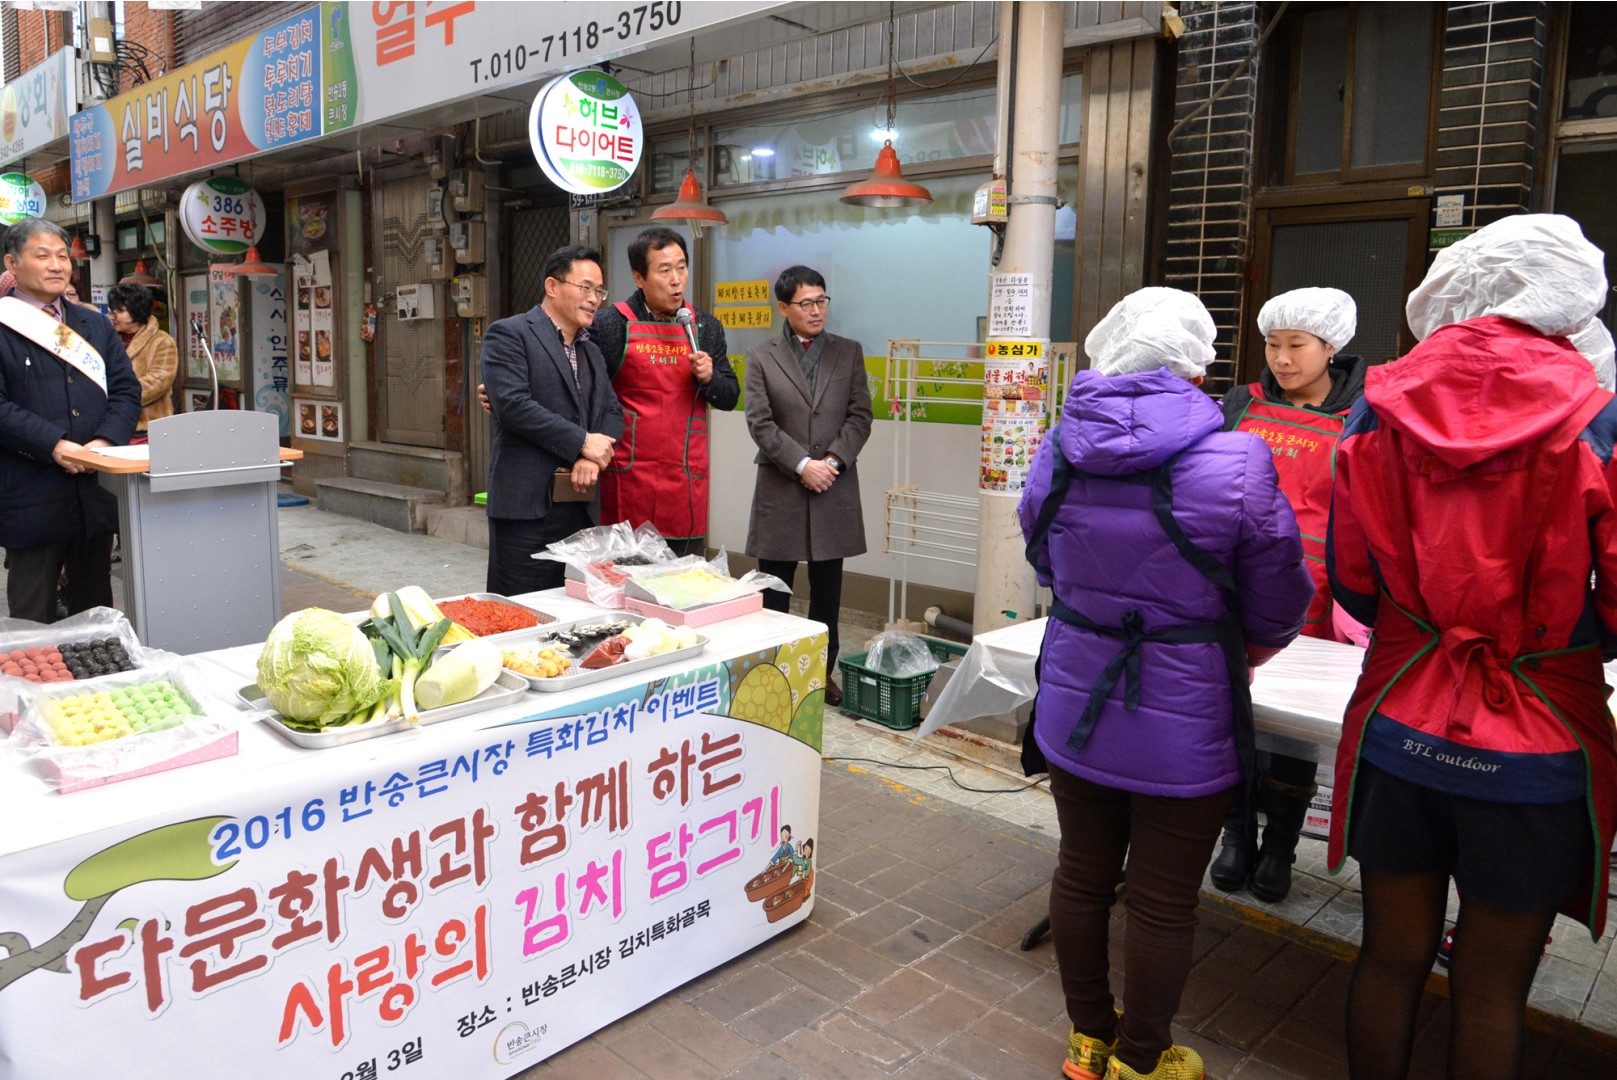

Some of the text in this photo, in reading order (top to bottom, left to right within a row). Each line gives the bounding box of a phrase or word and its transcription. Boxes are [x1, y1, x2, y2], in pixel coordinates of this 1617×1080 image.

[264, 20, 312, 58] 두부김치
[470, 2, 682, 84] T.010-7118-3750
[264, 50, 312, 90] 두루치기
[18, 71, 46, 128] 상회
[122, 61, 232, 173] 실비식당
[264, 80, 313, 118] 닭도리탕
[328, 104, 348, 124] 큰시장
[580, 98, 618, 130] 허브
[556, 125, 634, 162] 다이어트
[570, 162, 626, 180] 010-7118-3750
[213, 196, 243, 215] 386
[201, 215, 256, 239] 소주방
[636, 343, 688, 356] 반송2동큰시장
[998, 344, 1038, 356] 농심가
[1271, 446, 1299, 458] 녀회
[213, 680, 719, 860] 2016 반송큰시장 특화김치 이벤트
[1436, 752, 1502, 774] outdoor
[74, 732, 743, 1012] 다문화생과 함께 하는
[278, 786, 779, 1048] 사랑의 김치 담그기
[387, 1036, 423, 1071] 3일
[456, 1004, 498, 1038] 장소
[521, 948, 612, 1008] 반송큰시장
[618, 899, 711, 960] 김치특화골목
[506, 1024, 548, 1050] 반송큰시장
